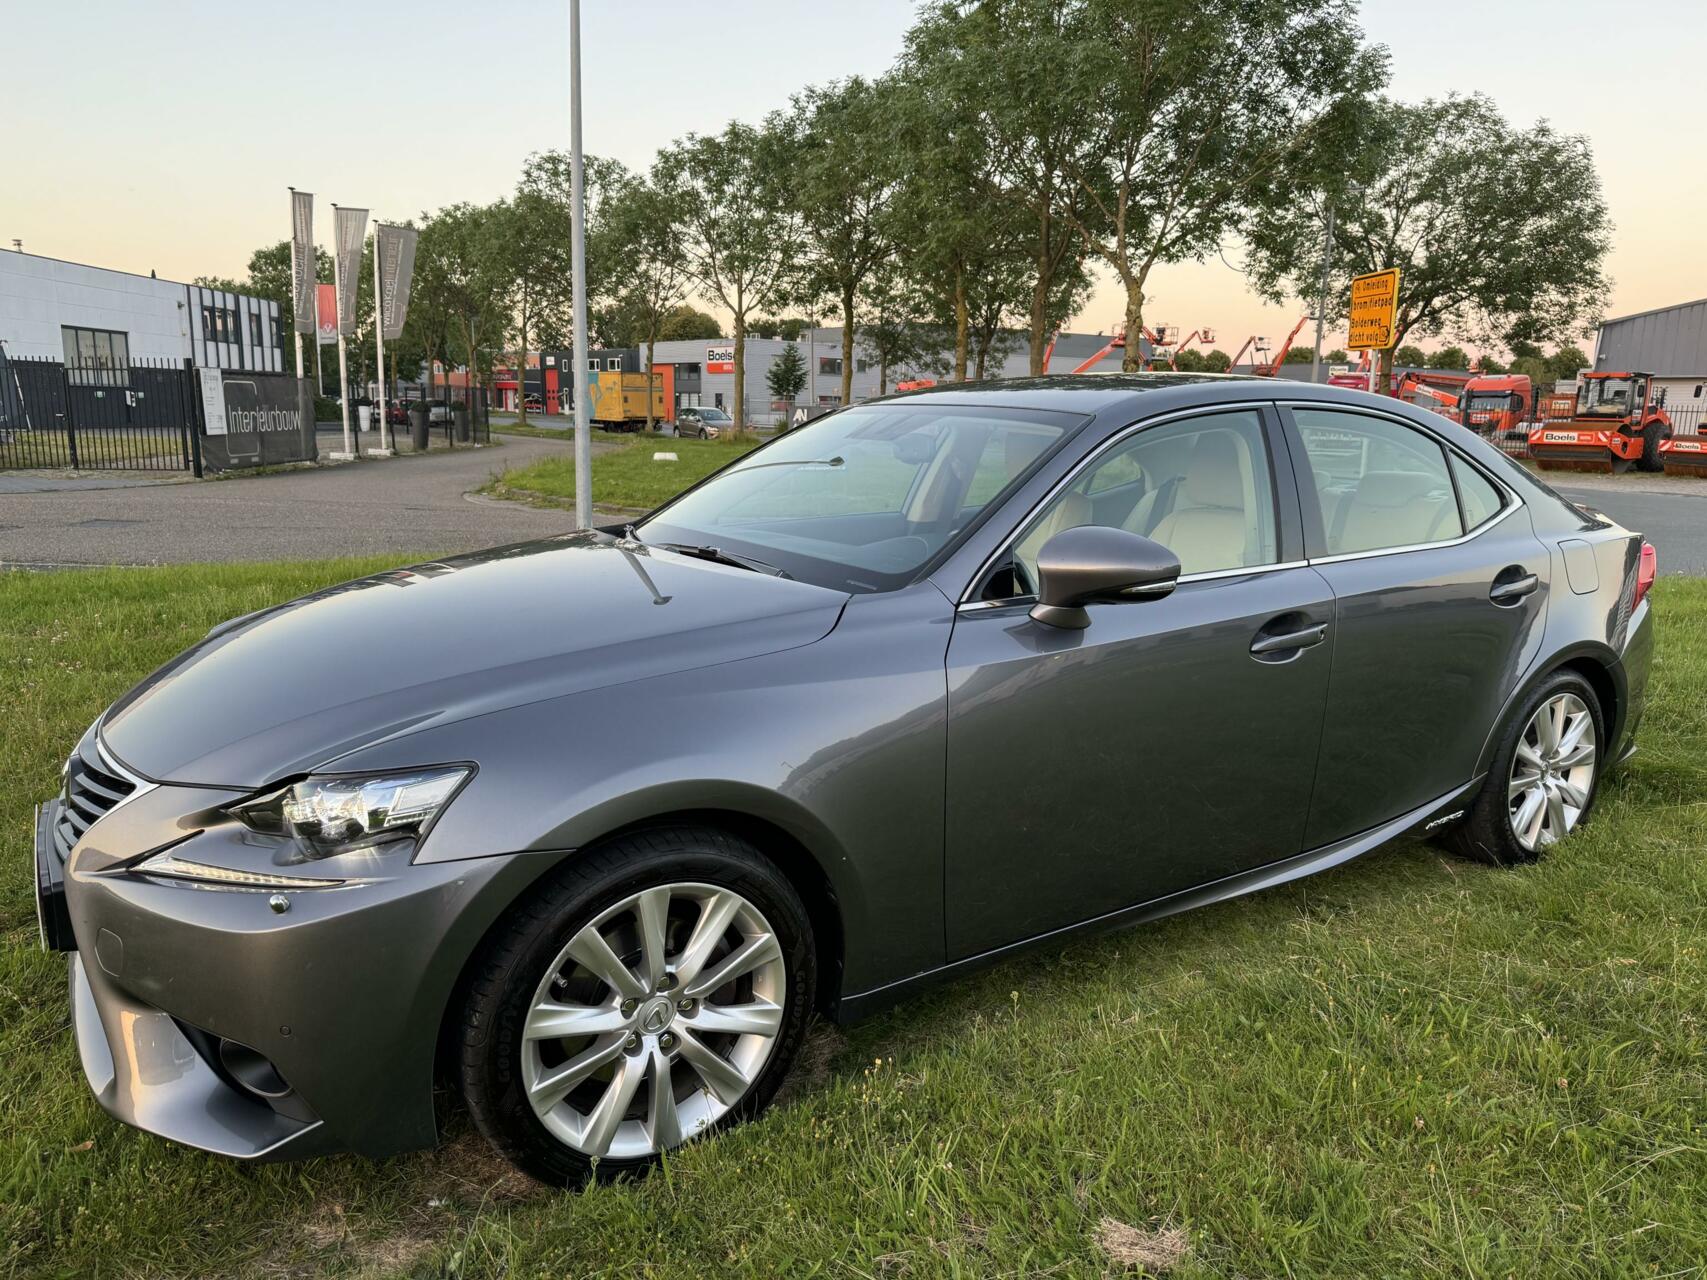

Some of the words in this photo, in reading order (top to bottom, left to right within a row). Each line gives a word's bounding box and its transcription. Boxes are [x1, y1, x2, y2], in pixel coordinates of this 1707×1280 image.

[1363, 279, 1388, 291] Omleiding
[1351, 317, 1381, 329] Bolderweg
[1349, 332, 1364, 342] dicht
[1366, 330, 1378, 344] volg
[708, 349, 733, 361] Boels
[228, 404, 300, 433] Interieurbouw
[1545, 433, 1576, 441] Boels
